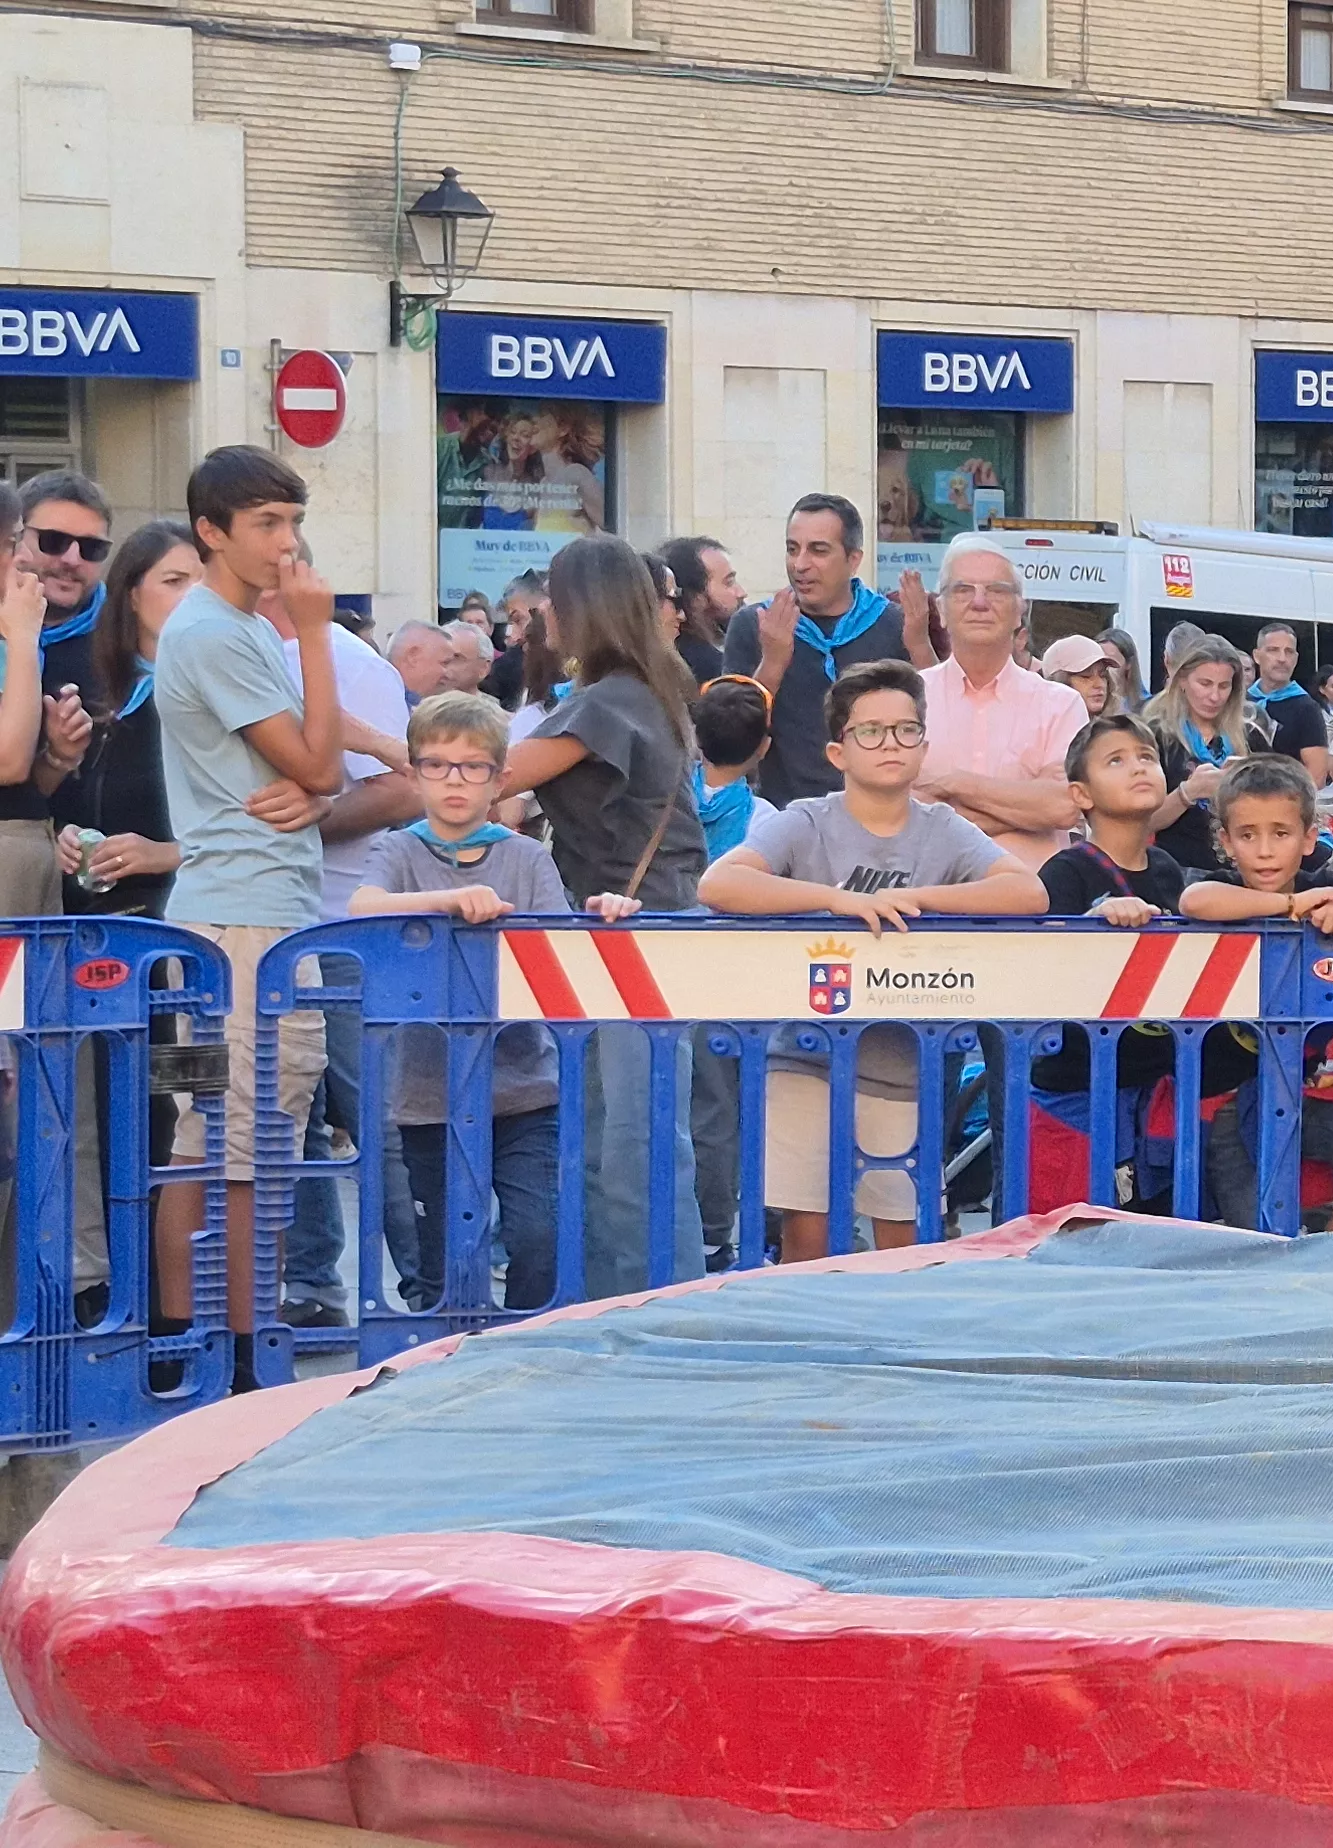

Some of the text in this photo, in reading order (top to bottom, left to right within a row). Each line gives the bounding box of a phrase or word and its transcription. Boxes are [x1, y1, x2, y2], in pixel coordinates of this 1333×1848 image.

[0, 307, 141, 357] BBVA
[491, 334, 616, 381] BBVA
[924, 350, 1032, 394] BBVA
[475, 540, 499, 554] Muy
[503, 540, 517, 552] de
[1070, 565, 1107, 582] CIVIL
[1164, 556, 1190, 574] 112
[447, 588, 477, 600] BBV
[843, 865, 911, 894] NIKE
[84, 963, 122, 983] JSP
[866, 967, 975, 989] Monzón
[866, 992, 976, 1005] Ayuntamiento
